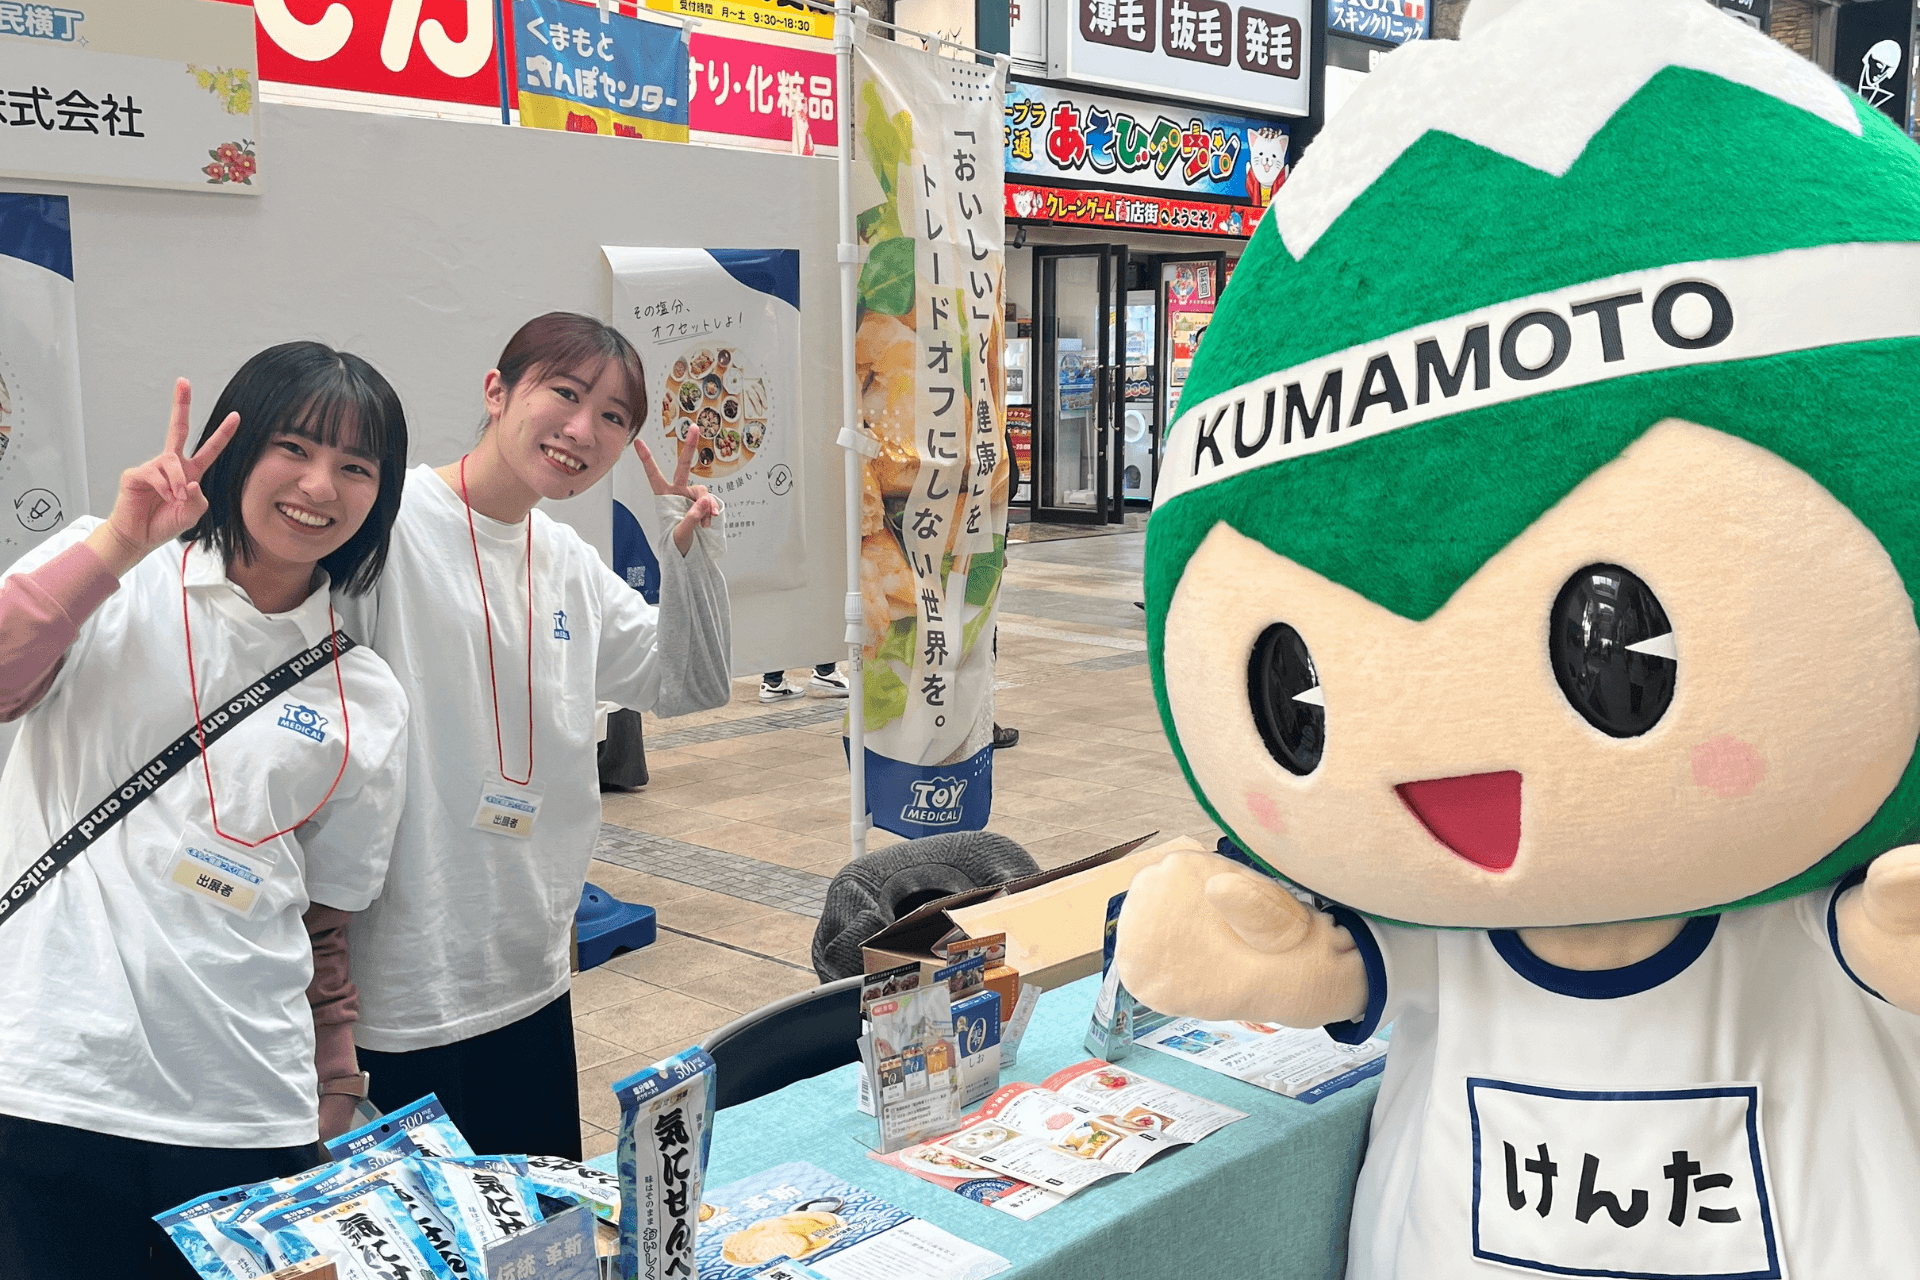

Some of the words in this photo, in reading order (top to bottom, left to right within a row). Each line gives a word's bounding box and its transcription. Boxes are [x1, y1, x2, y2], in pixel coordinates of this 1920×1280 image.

[680, 0, 713, 15] 受付時間
[1332, 7, 1424, 41] スキンクリニック
[527, 17, 613, 61] くまもと
[1170, 3, 1223, 57] 抜毛
[1246, 18, 1293, 70] 発毛
[526, 55, 677, 112] さんぽセンター
[1047, 101, 1240, 183] あそびタウン
[633, 298, 691, 320] その塩分、
[1193, 280, 1734, 478] KUMAMOTO
[290, 646, 323, 676] and
[229, 682, 271, 714] niko
[190, 711, 229, 747] and
[278, 717, 325, 742] MEDICAL
[284, 704, 328, 733] TOY
[121, 760, 168, 801] niko
[913, 781, 966, 808] TOY
[78, 799, 121, 840] and
[492, 814, 519, 829] 出展者
[906, 808, 958, 823] MEDICAL
[10, 856, 55, 898] niko
[196, 873, 234, 898] 出展者
[654, 1107, 692, 1280] 気にせんべ
[1502, 1140, 1741, 1229] けんた
[545, 1233, 581, 1267] 革新
